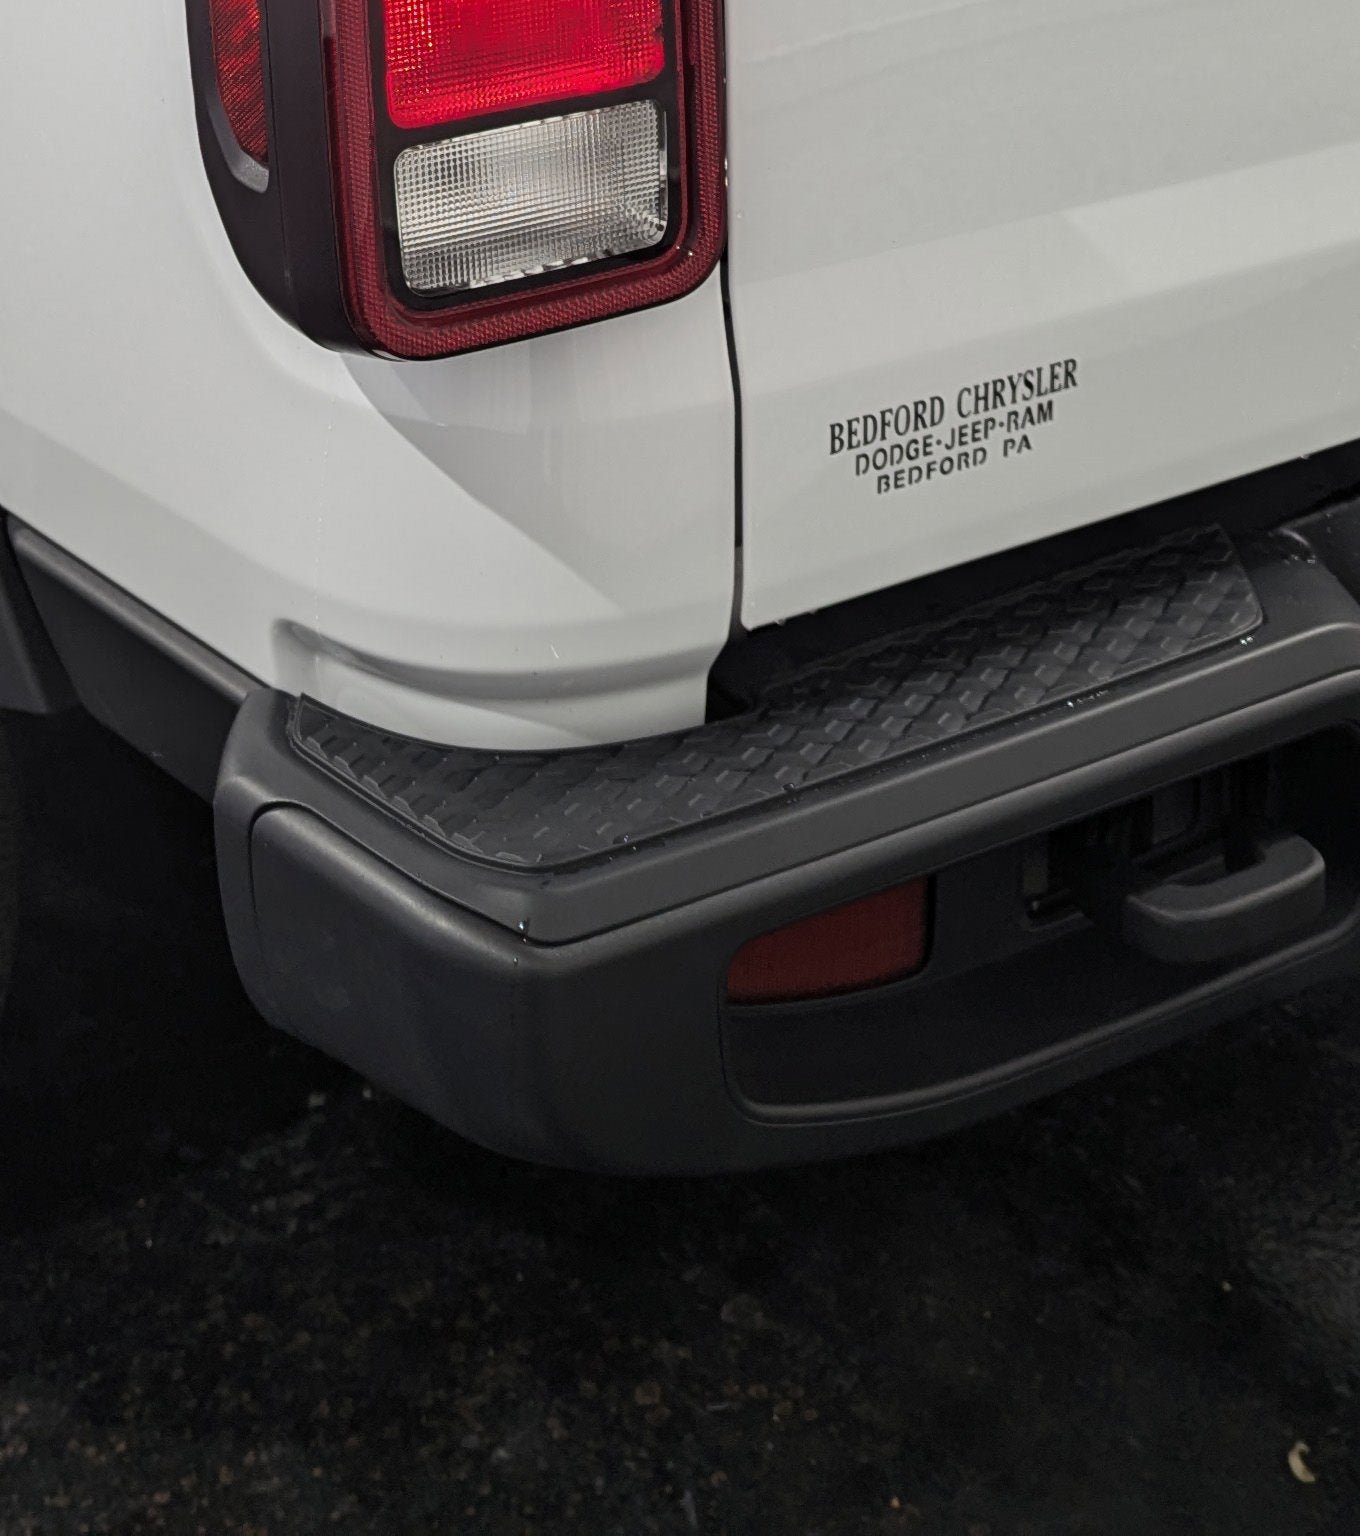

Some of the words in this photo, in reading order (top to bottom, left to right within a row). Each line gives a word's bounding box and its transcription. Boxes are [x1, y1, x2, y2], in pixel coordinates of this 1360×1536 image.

[828, 395, 945, 455] BEDFORD
[956, 358, 1078, 419] CHRYSLER
[876, 446, 987, 495] BEDFORD
[1002, 434, 1032, 458] PA
